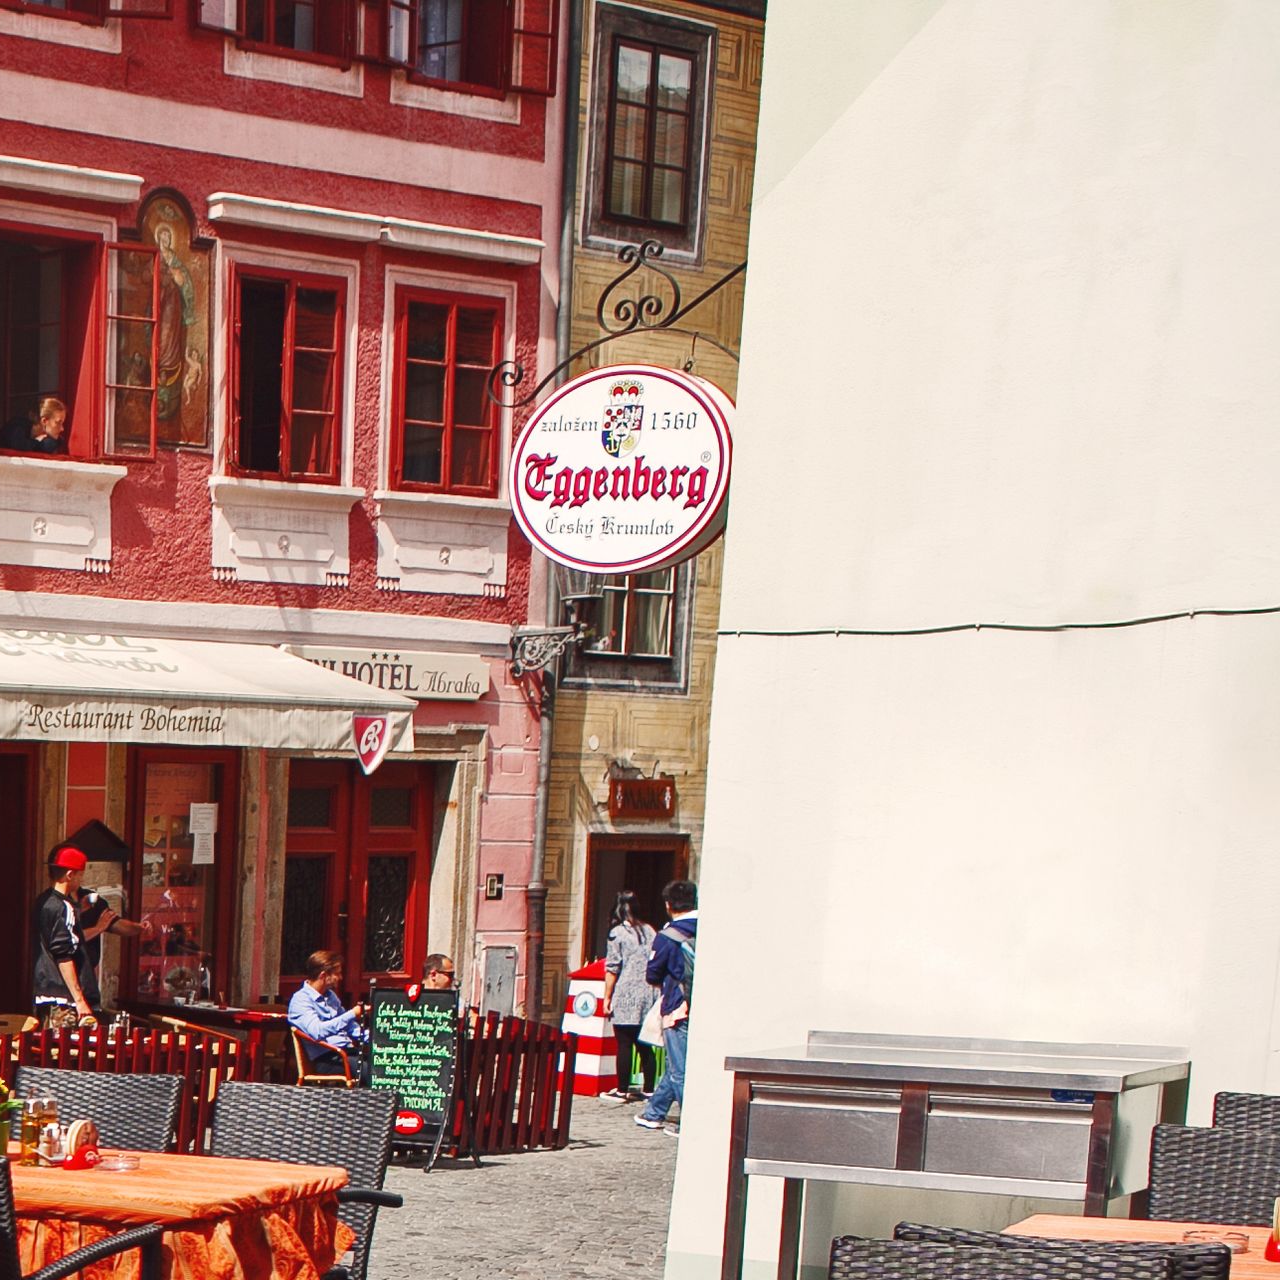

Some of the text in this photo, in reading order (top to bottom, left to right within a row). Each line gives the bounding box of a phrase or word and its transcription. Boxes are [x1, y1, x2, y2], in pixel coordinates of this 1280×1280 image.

[540, 411, 698, 432] založen 1560
[524, 452, 710, 510] Eggenberg
[545, 512, 675, 540] Český Krumlov
[342, 660, 420, 691] HOTEL
[422, 670, 481, 694] Abraka
[27, 703, 224, 734] Restaurant Bohemia
